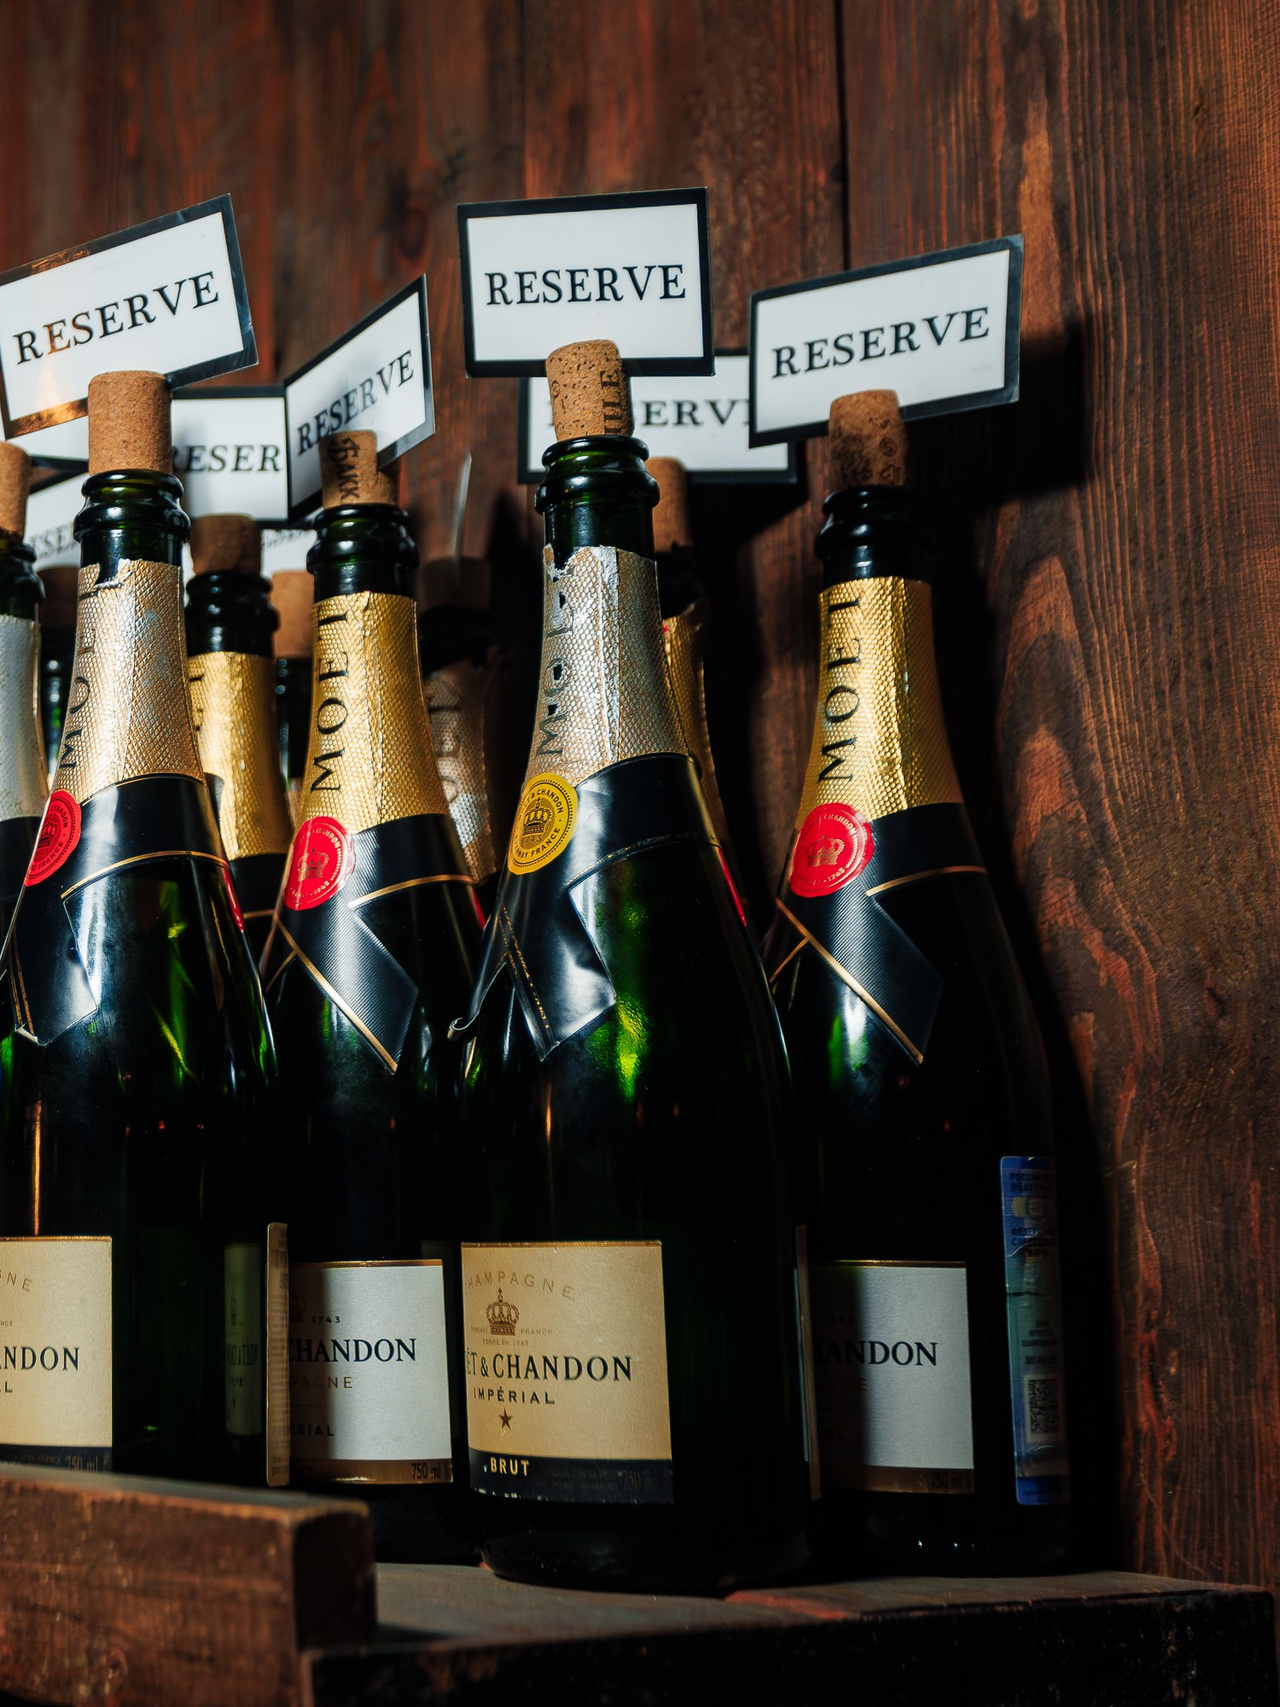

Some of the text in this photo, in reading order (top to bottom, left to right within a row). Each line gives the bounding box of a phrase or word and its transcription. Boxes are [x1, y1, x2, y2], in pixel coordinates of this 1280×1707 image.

[485, 263, 687, 306] RESERVE
[13, 271, 220, 366] RESERVE
[771, 306, 990, 380] RESERVE
[298, 350, 414, 456] RESERVE
[536, 788, 564, 814] CHANDON
[531, 827, 561, 858] FRANCE
[465, 1270, 575, 1300] HAMPAGNE
[311, 1315, 341, 1324] 1743
[480, 1356, 490, 1378] &
[492, 1352, 633, 1382] CHANDON
[473, 1386, 556, 1405] IMPÉRIAL
[411, 1462, 428, 1480] 750
[490, 1456, 531, 1477] BRUT
